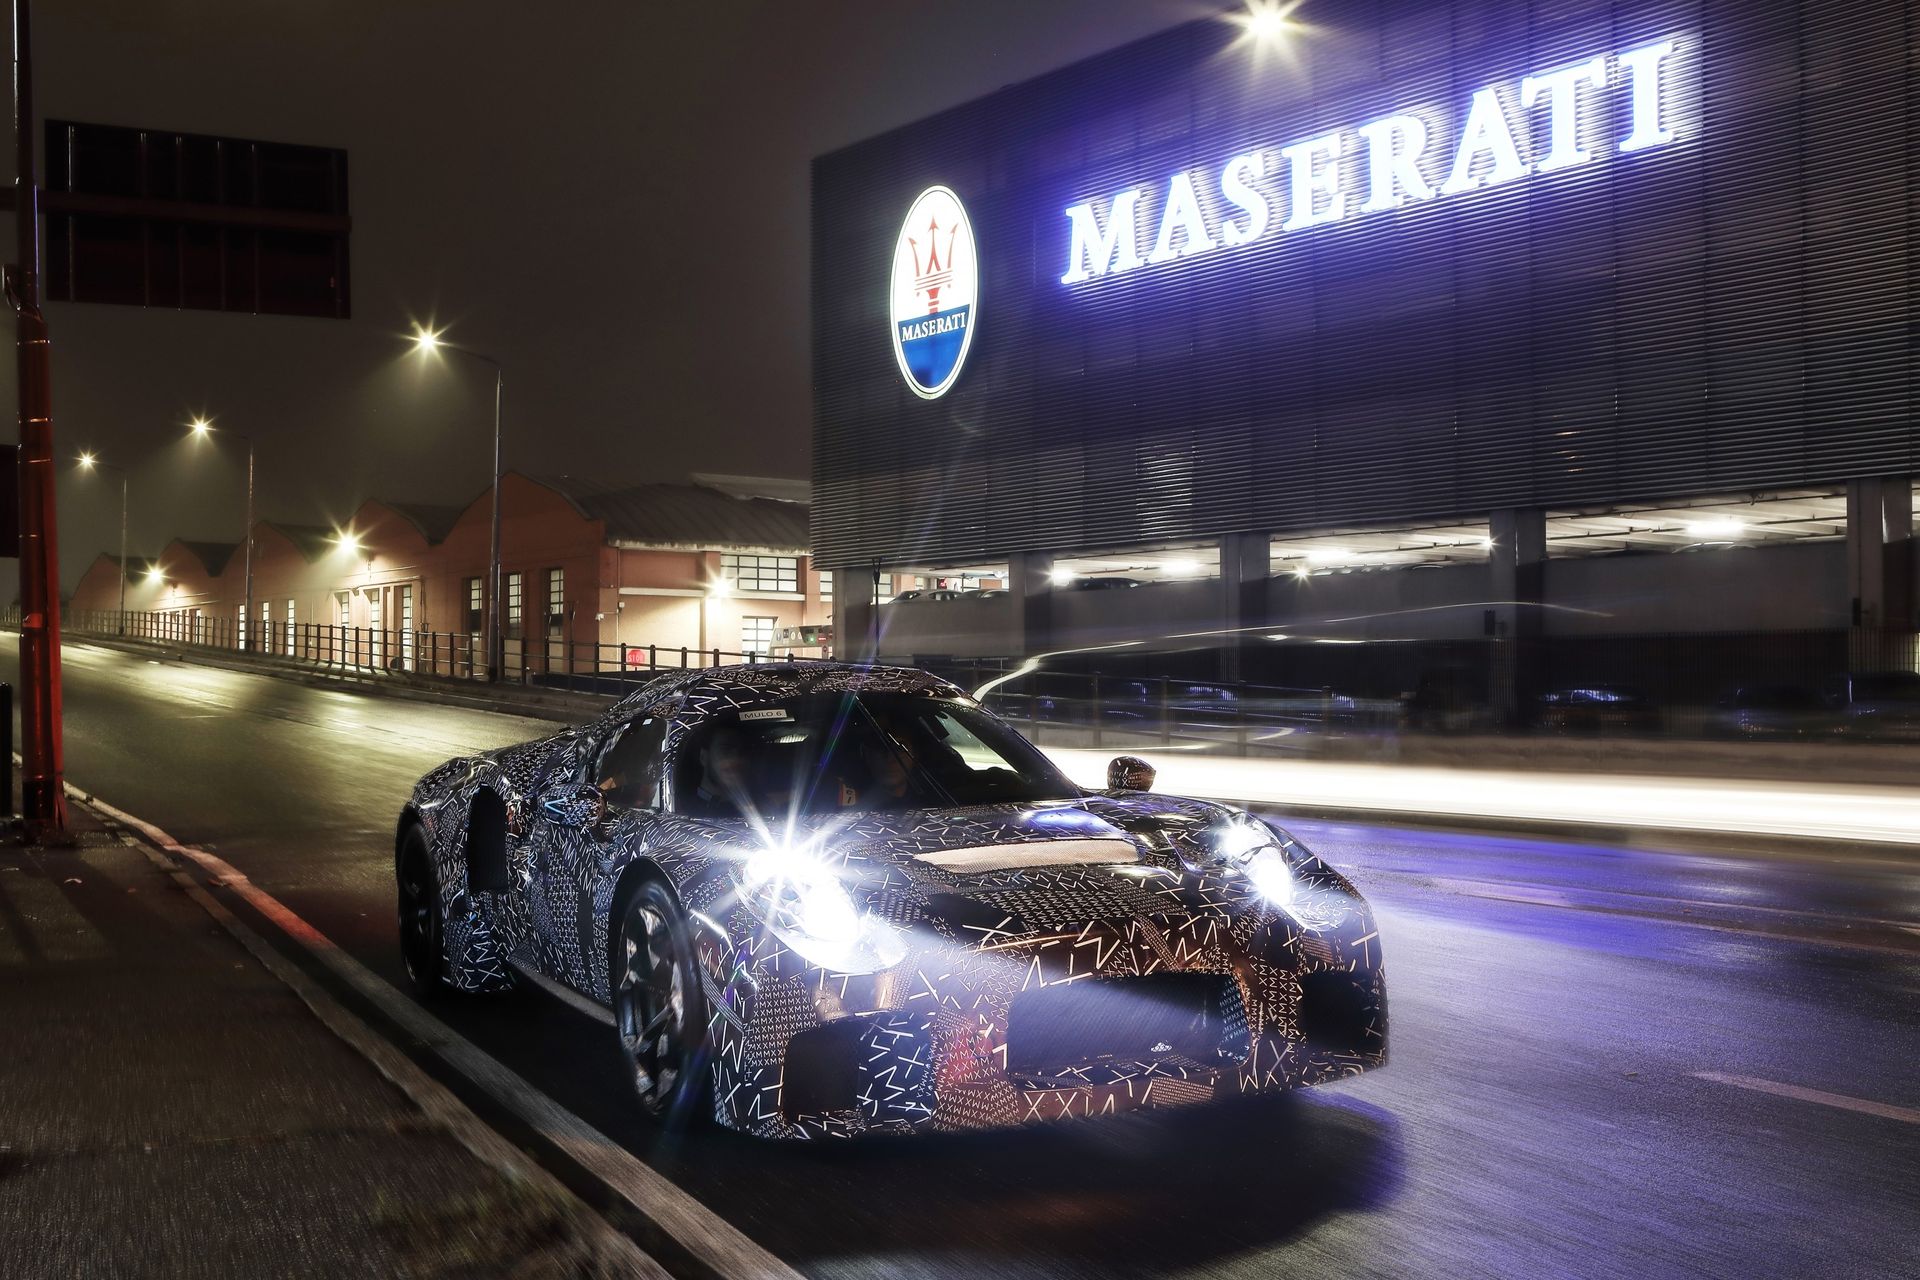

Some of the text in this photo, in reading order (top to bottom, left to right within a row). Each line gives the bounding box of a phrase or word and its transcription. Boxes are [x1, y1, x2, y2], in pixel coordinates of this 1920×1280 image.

[1060, 40, 1674, 285] MASERATI
[902, 312, 966, 342] MASERATI
[744, 710, 783, 719] MULO 6
